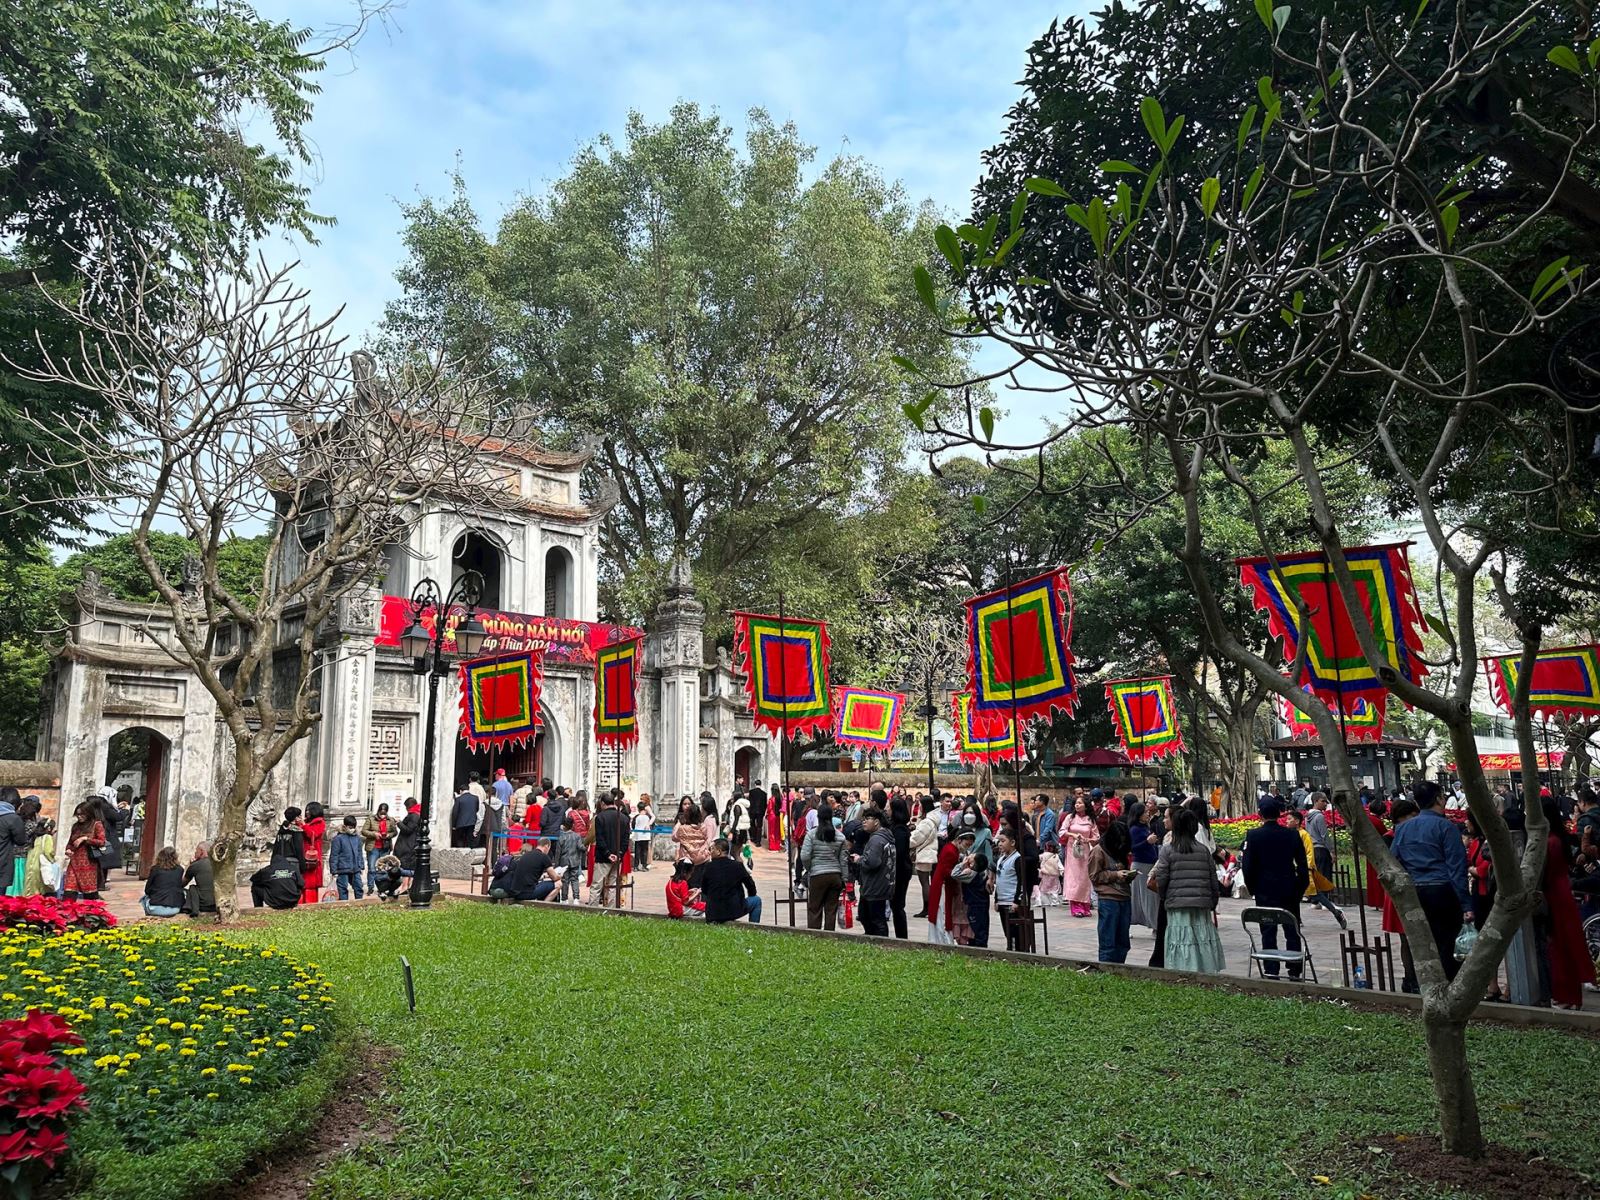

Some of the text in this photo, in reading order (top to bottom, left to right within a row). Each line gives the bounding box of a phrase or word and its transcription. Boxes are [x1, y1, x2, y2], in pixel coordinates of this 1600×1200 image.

[482, 617, 524, 637] MỪNG
[526, 623, 558, 641] NĂM
[561, 627, 585, 644] MỚI
